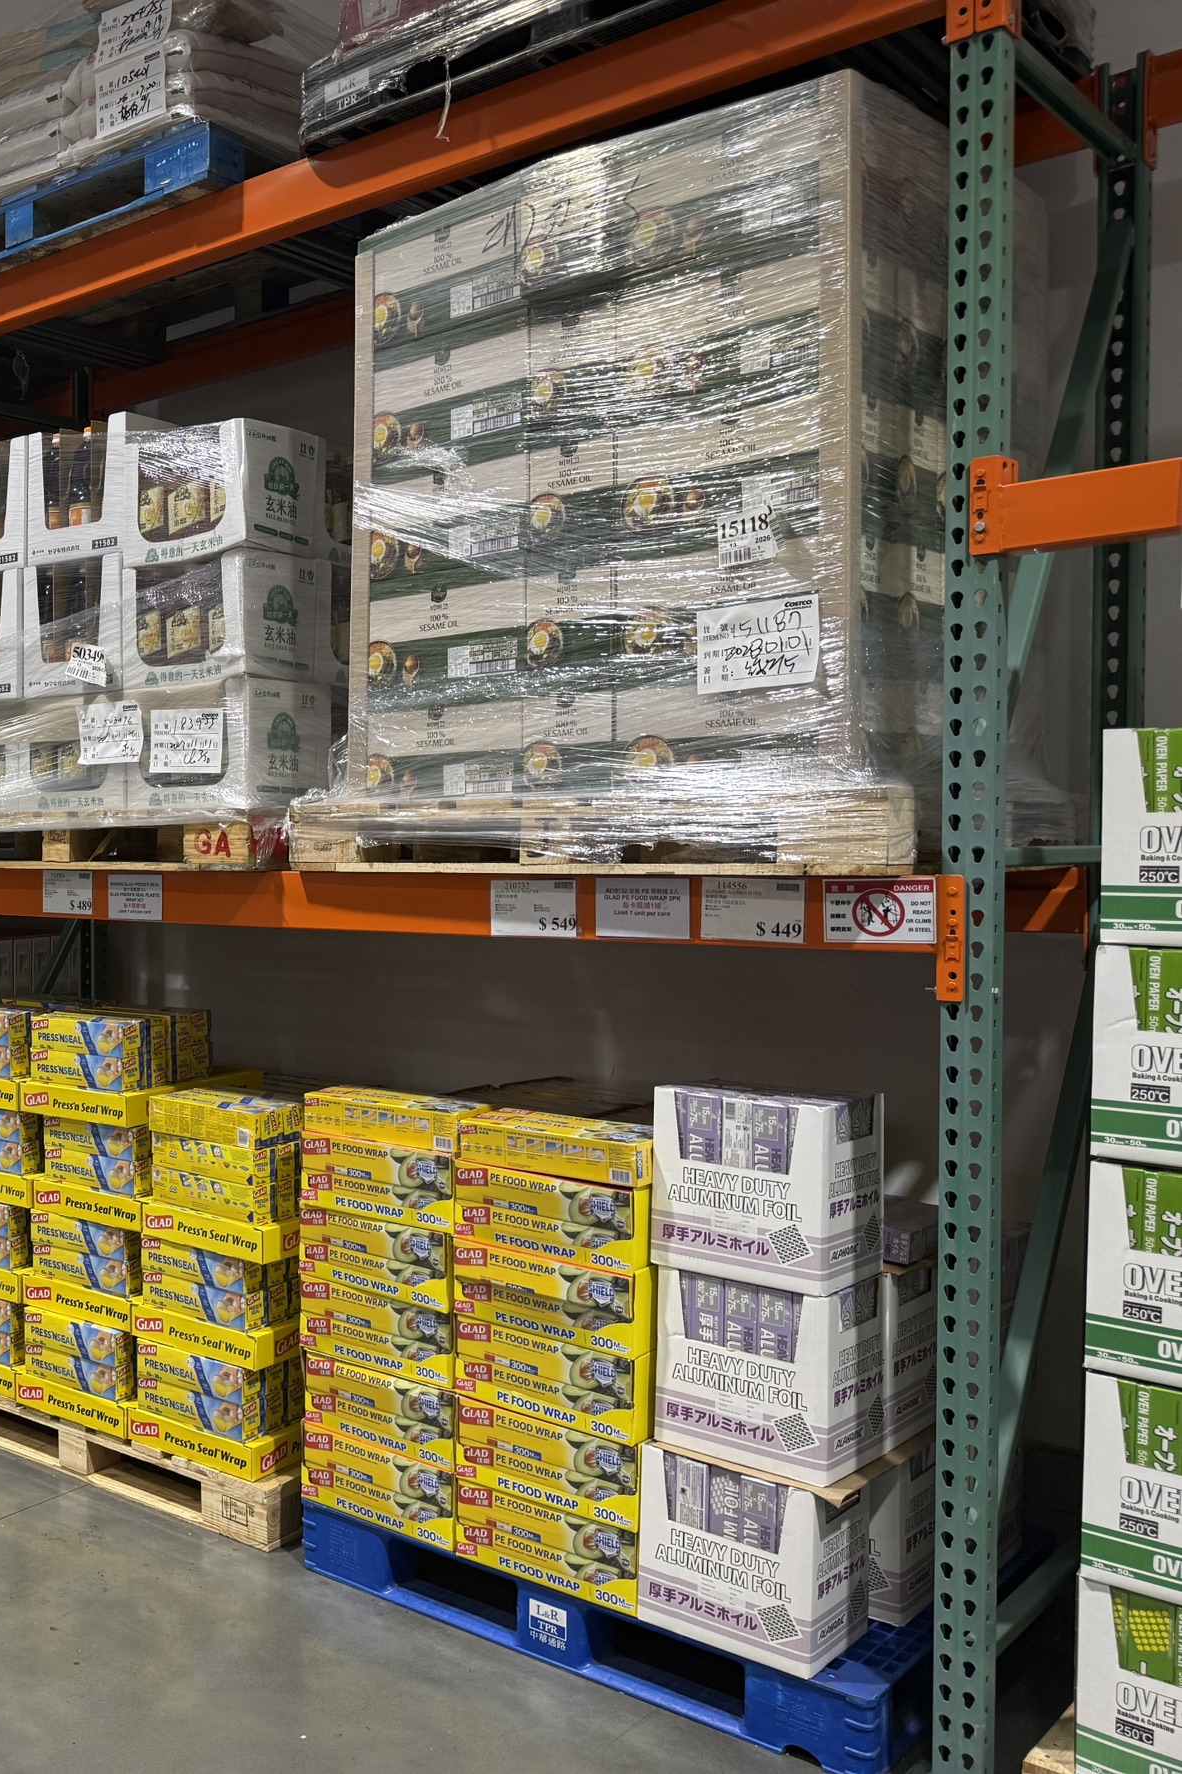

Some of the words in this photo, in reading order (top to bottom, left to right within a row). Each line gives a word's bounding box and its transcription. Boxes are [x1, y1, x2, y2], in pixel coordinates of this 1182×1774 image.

[423, 261, 451, 276] SESAME
[451, 257, 464, 267] OIL
[423, 383, 451, 397] SESAME
[451, 380, 464, 389] OIL
[547, 476, 578, 490] SESAME
[579, 474, 593, 484] OIL
[265, 494, 297, 520] 玄米油
[94, 539, 116, 549] 21582
[755, 535, 771, 543] 2026
[264, 624, 297, 645] 玄米油
[420, 622, 447, 632] SESAME
[447, 620, 460, 629] OIL
[543, 727, 575, 738] SESAME
[705, 720, 741, 728] SESAME
[417, 738, 444, 748] SESAME
[1156, 736, 1168, 761] OVEN
[268, 753, 299, 773] 玄米油
[1156, 762, 1168, 792] PAPER
[195, 828, 232, 858] GA
[1140, 854, 1165, 862] Baking
[504, 881, 530, 890] 210732
[893, 884, 931, 892] DANGER
[77, 900, 92, 911] 489
[551, 917, 577, 931] 549
[771, 922, 802, 938] 449
[1149, 955, 1161, 980] OVEN
[1148, 980, 1161, 1012] PAPER
[1131, 1044, 1182, 1074] OVE
[1132, 1072, 1156, 1081] Baking
[24, 1092, 49, 1106] GLAD
[52, 1097, 82, 1113] Press'n
[103, 1106, 123, 1120] Wrap
[303, 1138, 327, 1150] GLAD
[331, 1142, 342, 1152] PE
[342, 1144, 367, 1156] FOOD
[367, 1147, 389, 1159] WRAP
[456, 1168, 483, 1182] GLAD
[490, 1172, 501, 1184] PE
[502, 1175, 529, 1190] FOOD
[530, 1180, 557, 1193] WRAP
[683, 1166, 740, 1193] HEAVY
[741, 1174, 791, 1200] DUTY
[335, 1196, 348, 1208] PE
[348, 1199, 373, 1215] FOOD
[374, 1204, 404, 1219] WRAP
[668, 1184, 760, 1216] ALUMINUM
[763, 1200, 803, 1223] FOIL
[145, 1215, 173, 1230] GLAD
[177, 1220, 209, 1238] Press'n
[233, 1235, 258, 1251] Wrap
[662, 1223, 770, 1257] 厚手アルミホイル
[494, 1232, 510, 1245] PE
[511, 1236, 541, 1254] FOOD
[543, 1242, 576, 1260] WRAP
[1124, 1289, 1148, 1300] Baking
[1139, 1391, 1150, 1417] OVEN
[1137, 1416, 1150, 1446] PAPER
[131, 1421, 159, 1437] GLAD
[164, 1431, 196, 1451] Press'n
[220, 1450, 247, 1470] Wrap
[1120, 1502, 1145, 1515] Baking
[1150, 1509, 1180, 1524] Cooking
[671, 1528, 728, 1559] HEAVY
[729, 1547, 780, 1577] DUTY
[499, 1556, 514, 1569] PE
[515, 1560, 545, 1580] FOOD
[546, 1570, 581, 1592] WRAP
[654, 1543, 749, 1590] ALUMINUM
[751, 1574, 792, 1604] FOIL
[536, 1604, 560, 1622] L&R
[648, 1581, 758, 1631] 厚手アルミホイル
[537, 1620, 559, 1636] TPR
[529, 1630, 566, 1651] 中華通路
